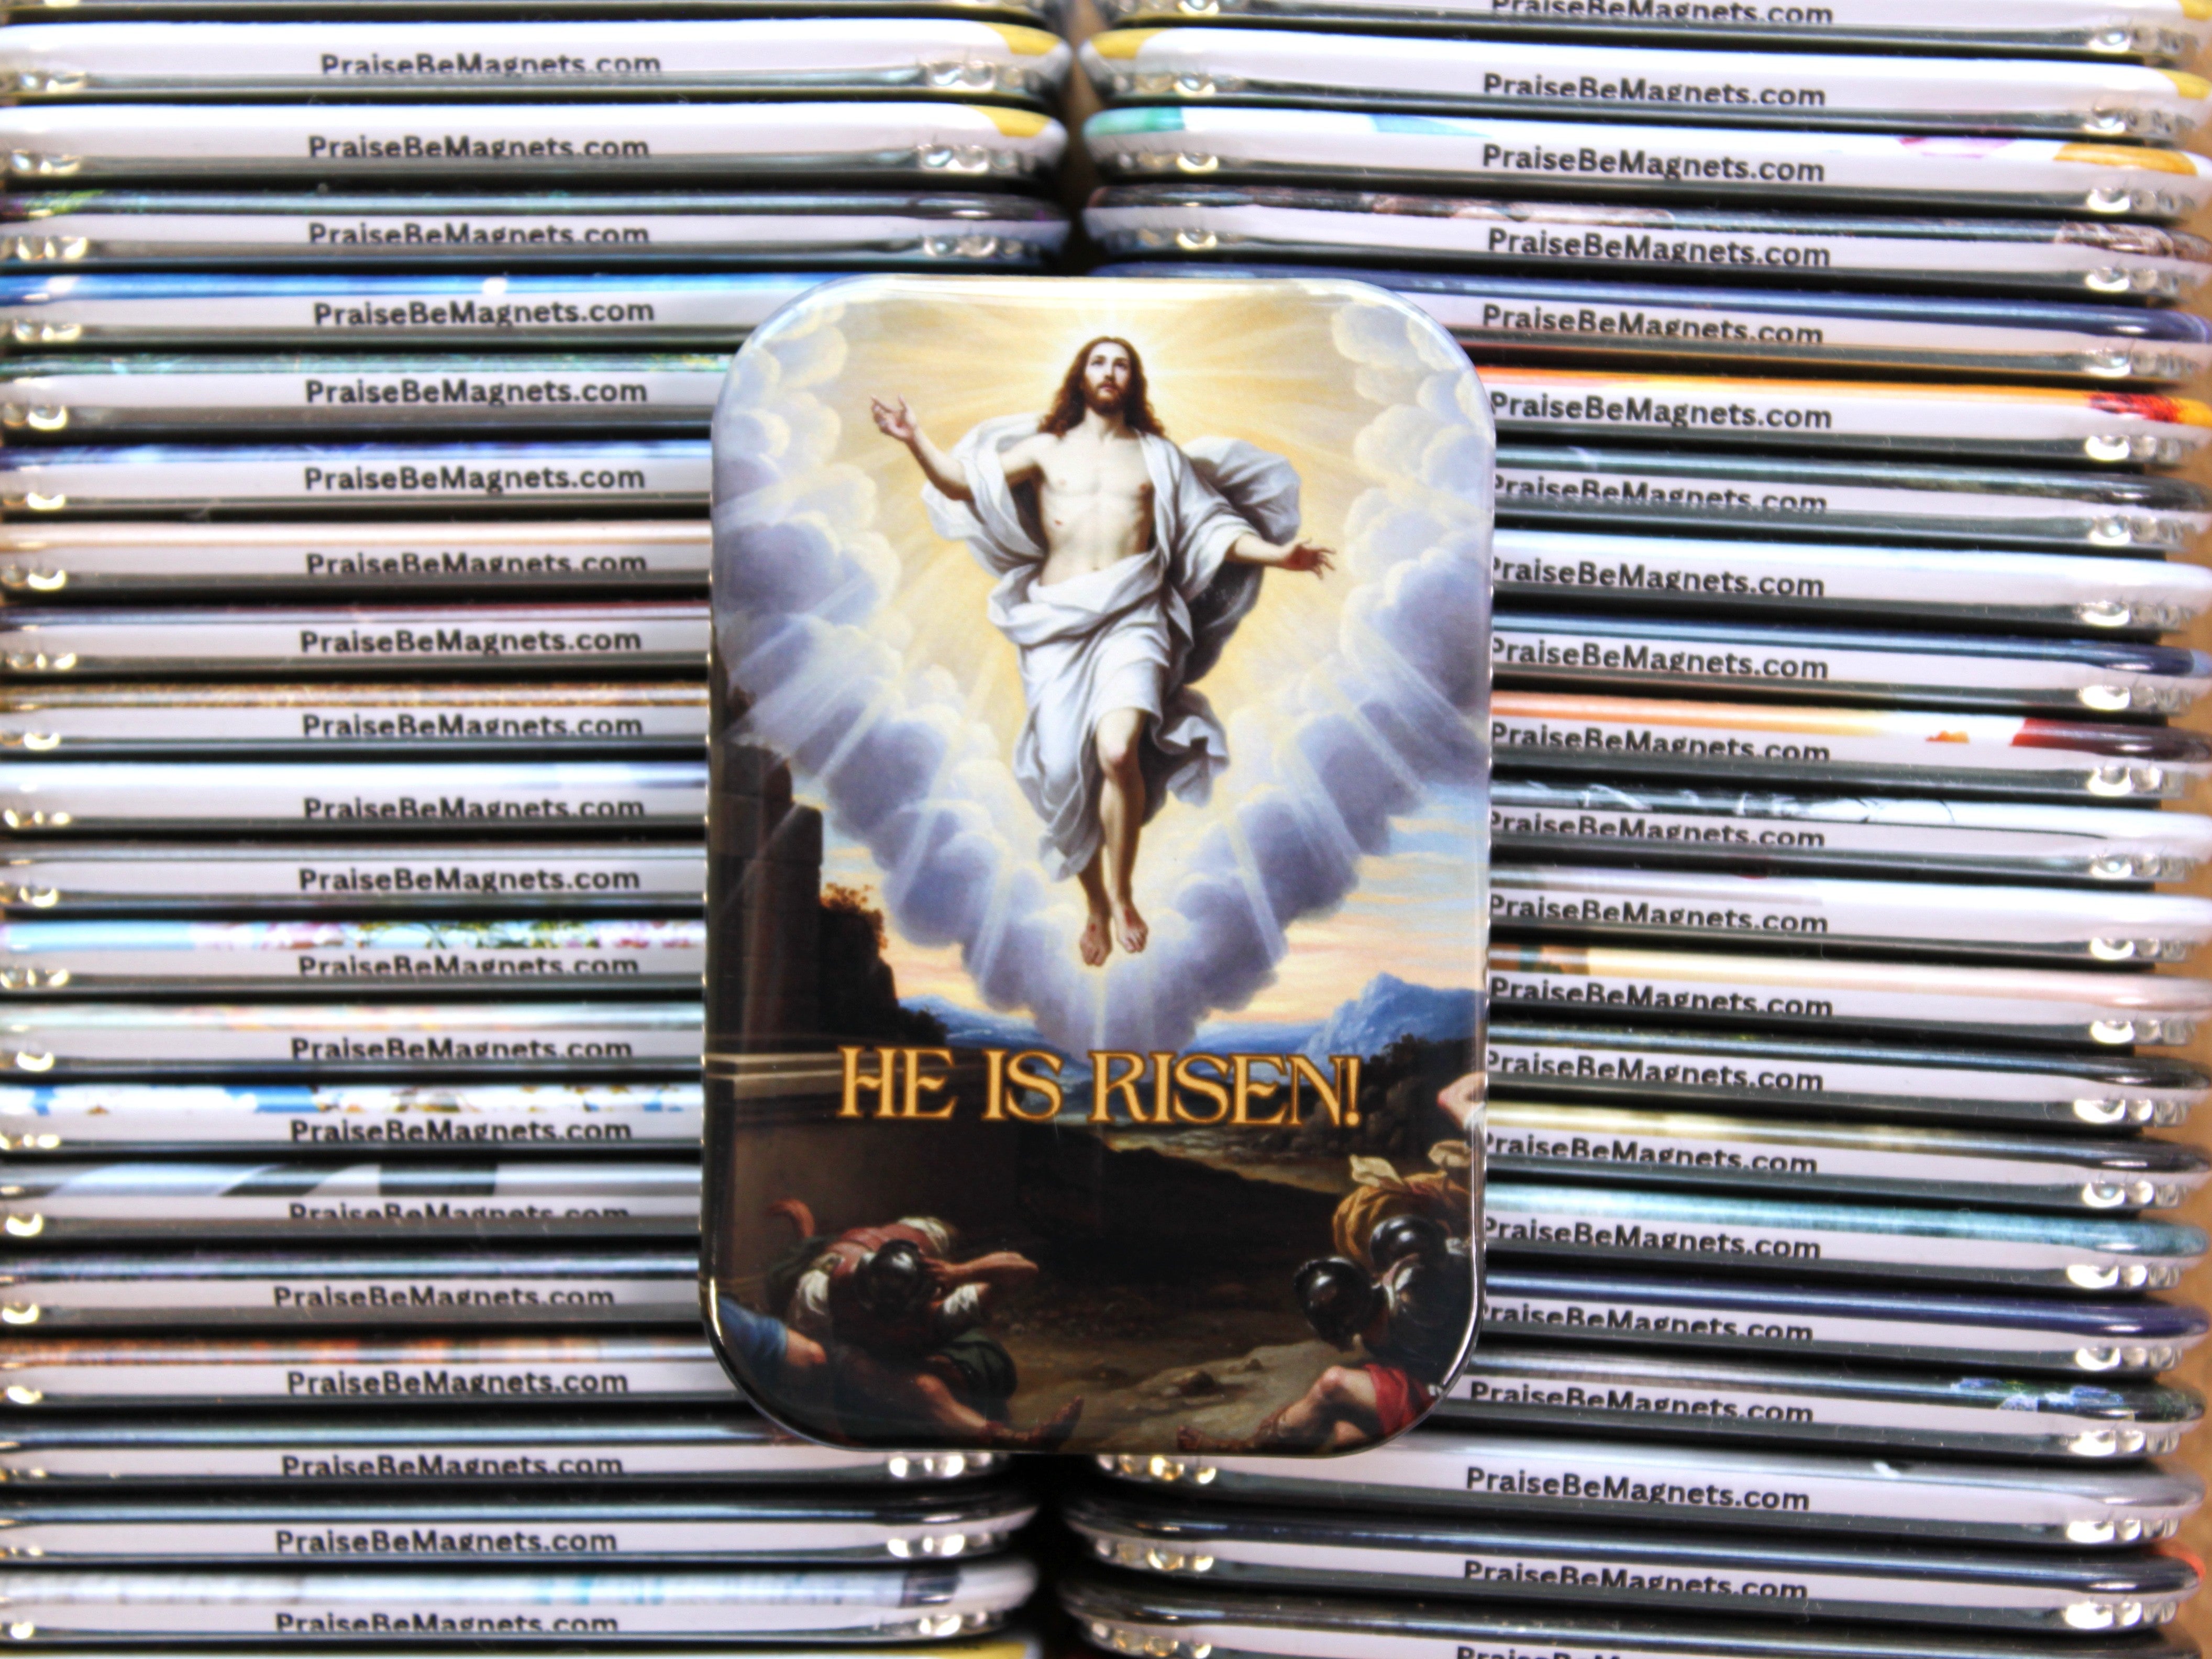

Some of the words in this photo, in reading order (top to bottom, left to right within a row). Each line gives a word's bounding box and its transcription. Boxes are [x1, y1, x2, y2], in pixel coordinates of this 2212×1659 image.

[1484, 73, 1826, 106] PraiseBeMagnets.com
[308, 136, 649, 158] PraiseBeMagnets.com
[1483, 143, 1824, 182] PraiseBeMagnets.com
[1489, 227, 1831, 267] PraiseBeMagnets.com
[314, 301, 655, 328] PraiseBeMagnets.com
[1483, 304, 1823, 344] PraiseBeMagnets.com
[305, 379, 647, 407] PraiseBeMagnets.com
[1491, 392, 1832, 429] PraiseBeMagnets.com
[304, 466, 645, 495] PraiseBeMagnets.com
[1495, 473, 1827, 510] PraiseBeMagnetscom
[306, 552, 647, 575] PraiseBeMagnetscom
[301, 630, 642, 656] PraiseBeMagnets.com
[1492, 637, 1828, 680] PraiseBeMagnets.com
[303, 714, 643, 737] PraiseBeMagnets.com
[1491, 722, 1830, 761] PraiseBeMagnetscom
[1491, 812, 1825, 847] PraiseBeMagnets.com
[299, 868, 640, 893] PraiseBeMagnets.com
[1490, 894, 1828, 933] PraiseBeMagnets.com
[298, 956, 639, 977] PraiseBeMagnetscom
[1491, 977, 1833, 1017] PraiseBeMagnets.com
[836, 1045, 959, 1121] HE
[982, 1047, 1064, 1124] IS
[1086, 1049, 1362, 1127] RISEN!
[1488, 1050, 1823, 1091] PraiseBeMagnets.com
[291, 1120, 632, 1143] PraiseBeMagnets.com
[290, 1203, 629, 1220] PraiseBeManetscom
[1485, 1216, 1821, 1258] PraiseBeMagnets.com
[1484, 1303, 1814, 1340] raiseBeMagnetscom
[287, 1371, 628, 1395] PraiseBeMagnets.com
[1467, 1467, 1810, 1510] PraiseBeMagnets.com
[275, 1530, 617, 1554] PraiseBeMagnets.com
[275, 1612, 618, 1633] PraiseBeMagnetscom
